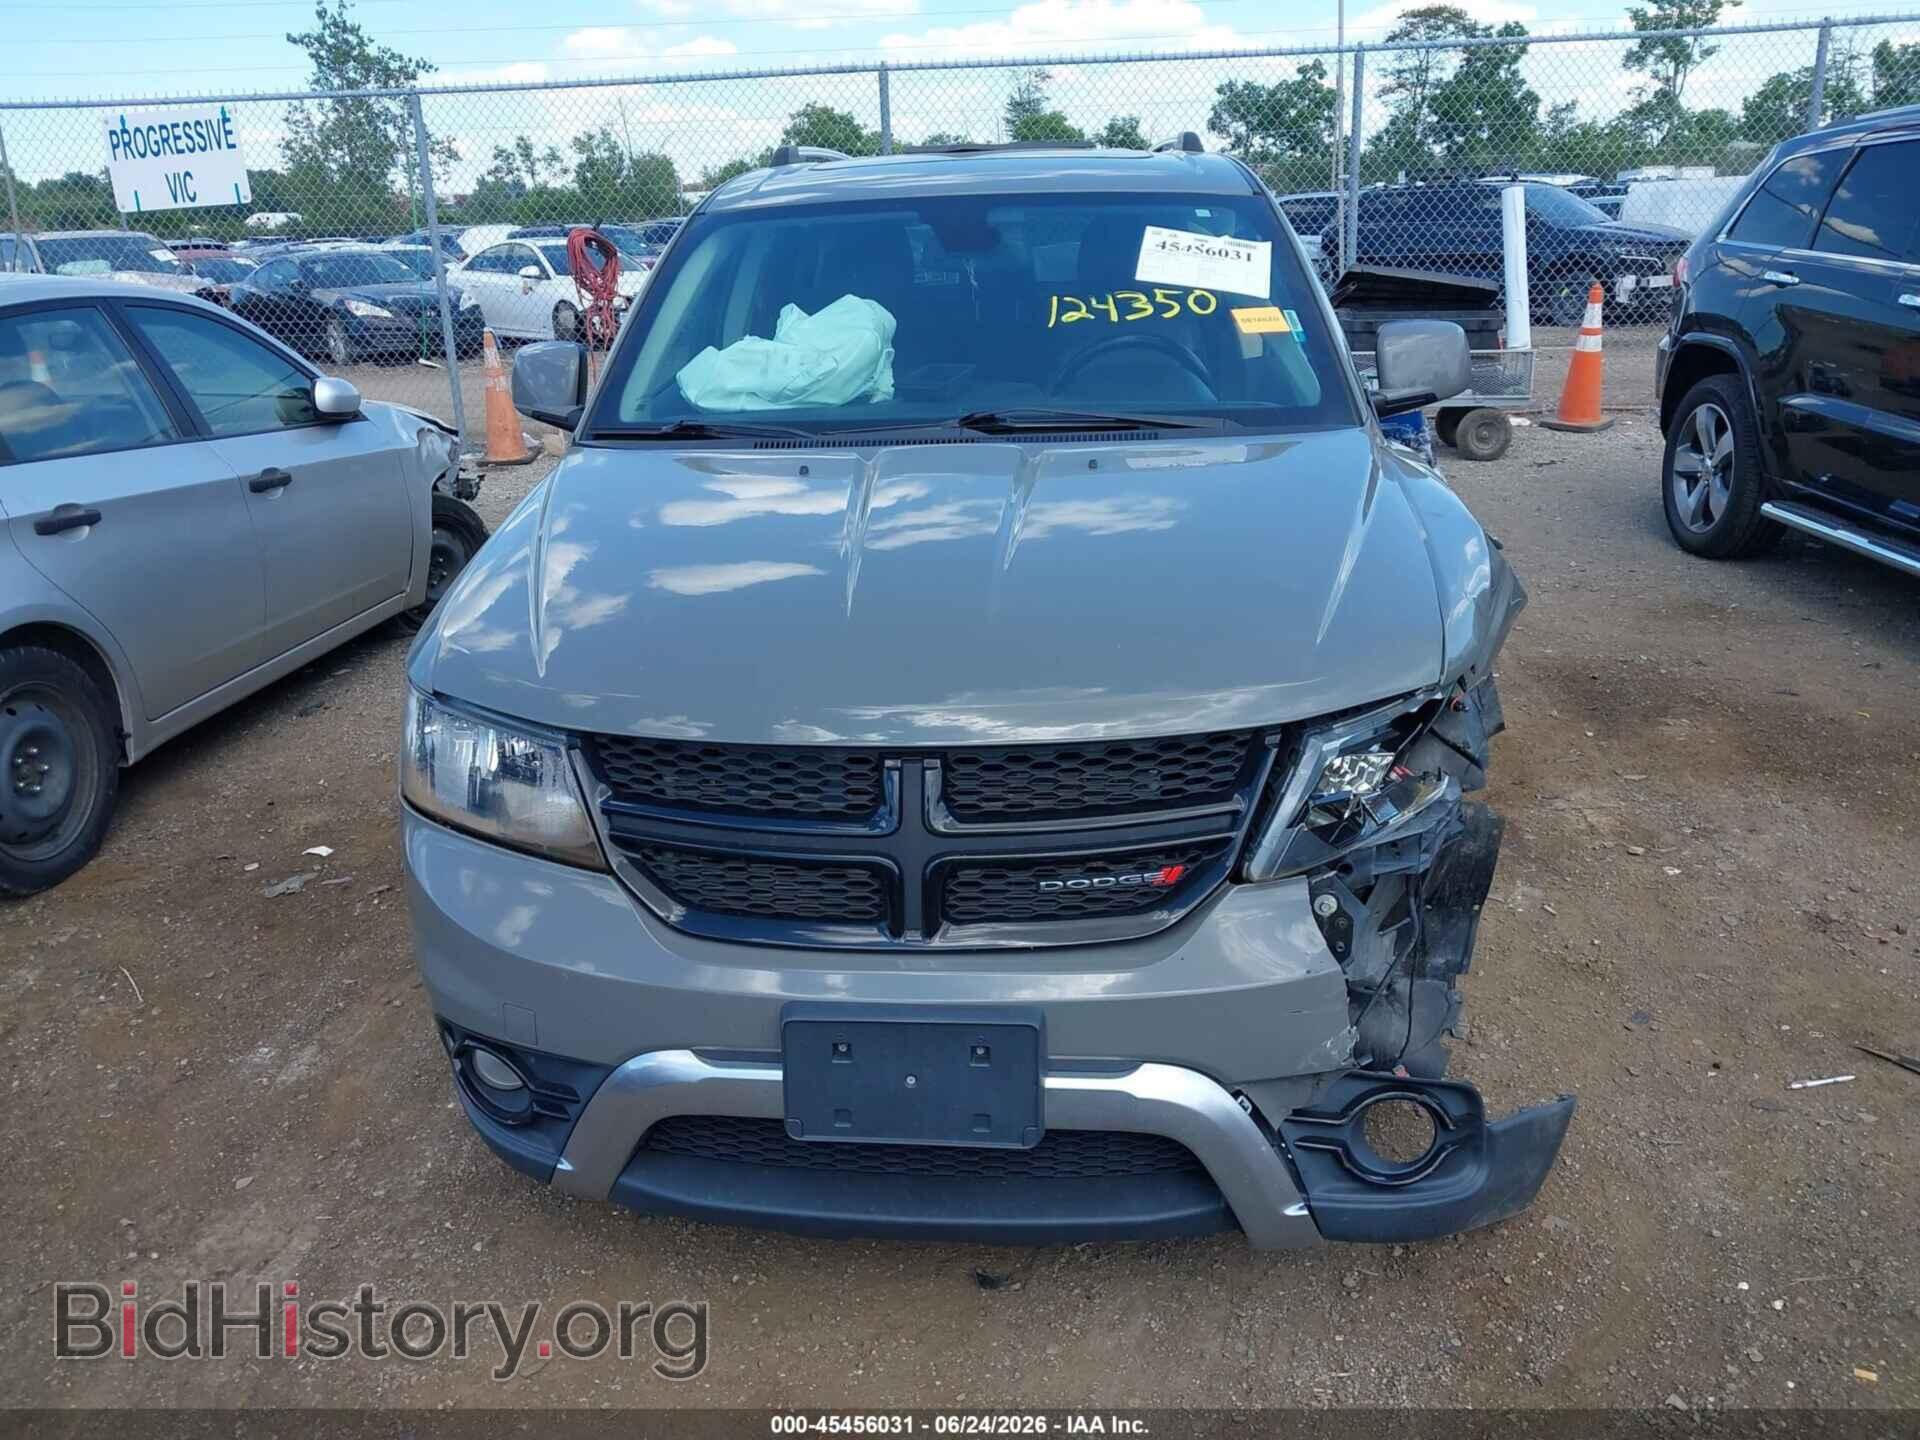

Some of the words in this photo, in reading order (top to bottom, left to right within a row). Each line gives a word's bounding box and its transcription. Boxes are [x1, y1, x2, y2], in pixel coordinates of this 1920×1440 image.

[108, 117, 237, 161] PROGRESSIVE
[164, 170, 198, 204] VIC
[1047, 288, 1218, 328] 124350
[1039, 871, 1166, 892] DODGE
